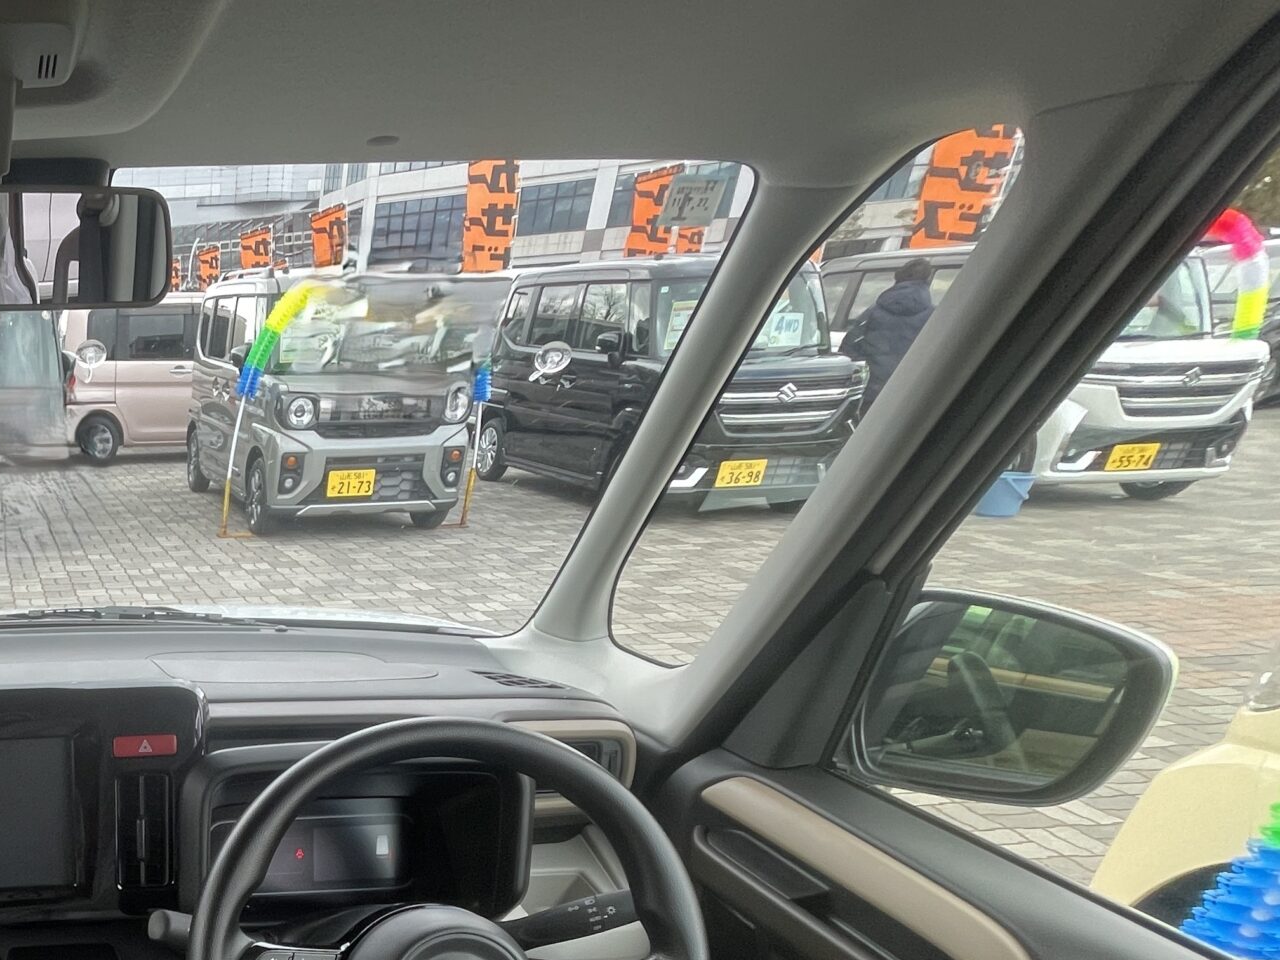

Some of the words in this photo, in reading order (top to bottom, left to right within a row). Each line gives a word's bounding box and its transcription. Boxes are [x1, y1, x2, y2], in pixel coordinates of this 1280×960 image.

[774, 315, 800, 335] 4WD
[725, 470, 762, 485] 36-98
[337, 480, 372, 495] 21-73
